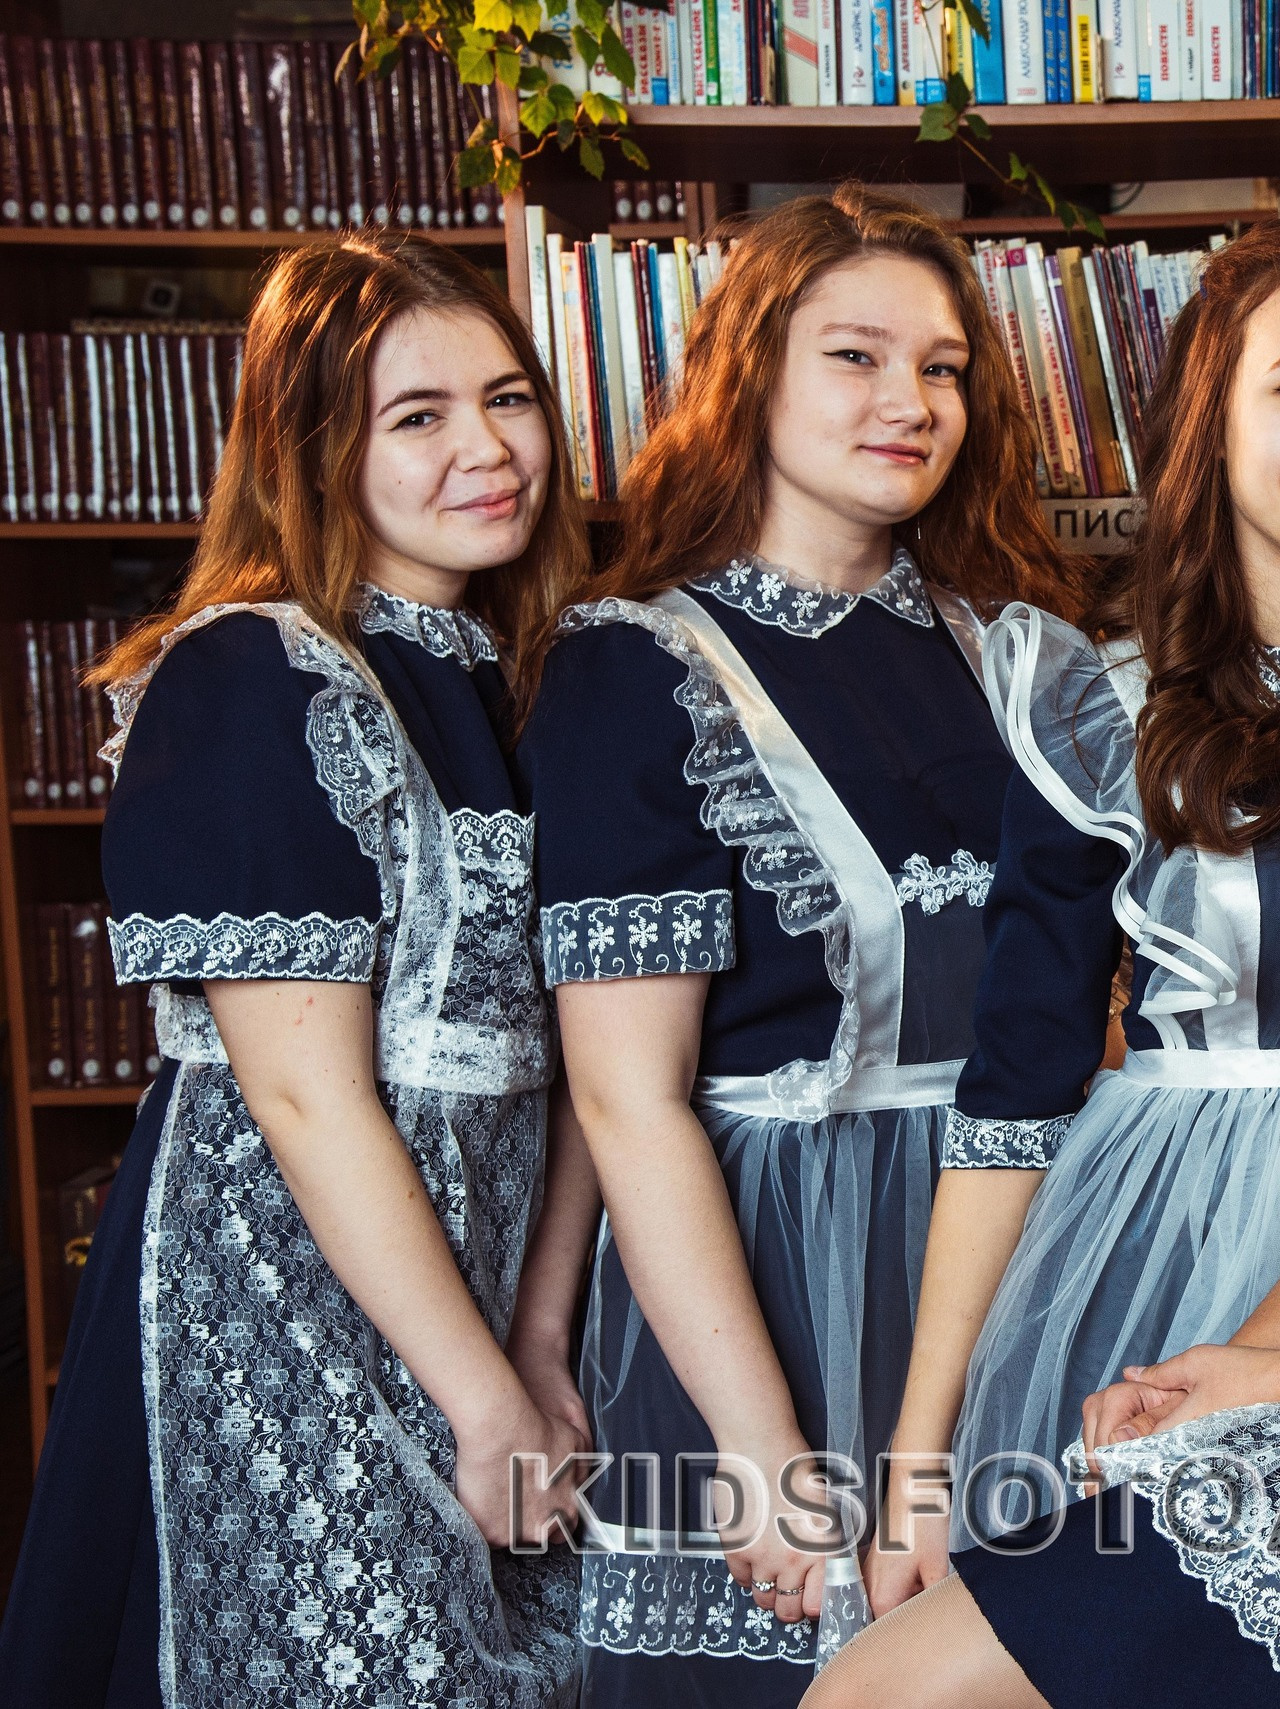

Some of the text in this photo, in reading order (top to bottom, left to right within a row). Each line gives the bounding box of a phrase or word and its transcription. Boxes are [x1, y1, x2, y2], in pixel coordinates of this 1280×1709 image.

[638, 25, 648, 94] РАССКАЗЫ
[901, 19, 910, 72] ДРЕВНИЕ
[1019, 17, 1030, 78] АЛЕКСАНДР
[1160, 25, 1169, 81] ПОВЕСТИ
[1212, 26, 1220, 82] ПОВЕСТИ
[1006, 311, 1021, 349] КАША
[1046, 346, 1058, 370] ЖИТЬ
[1052, 373, 1063, 395] РУСИ
[1039, 395, 1064, 484] ТРИ ТОЛСТЯКА
